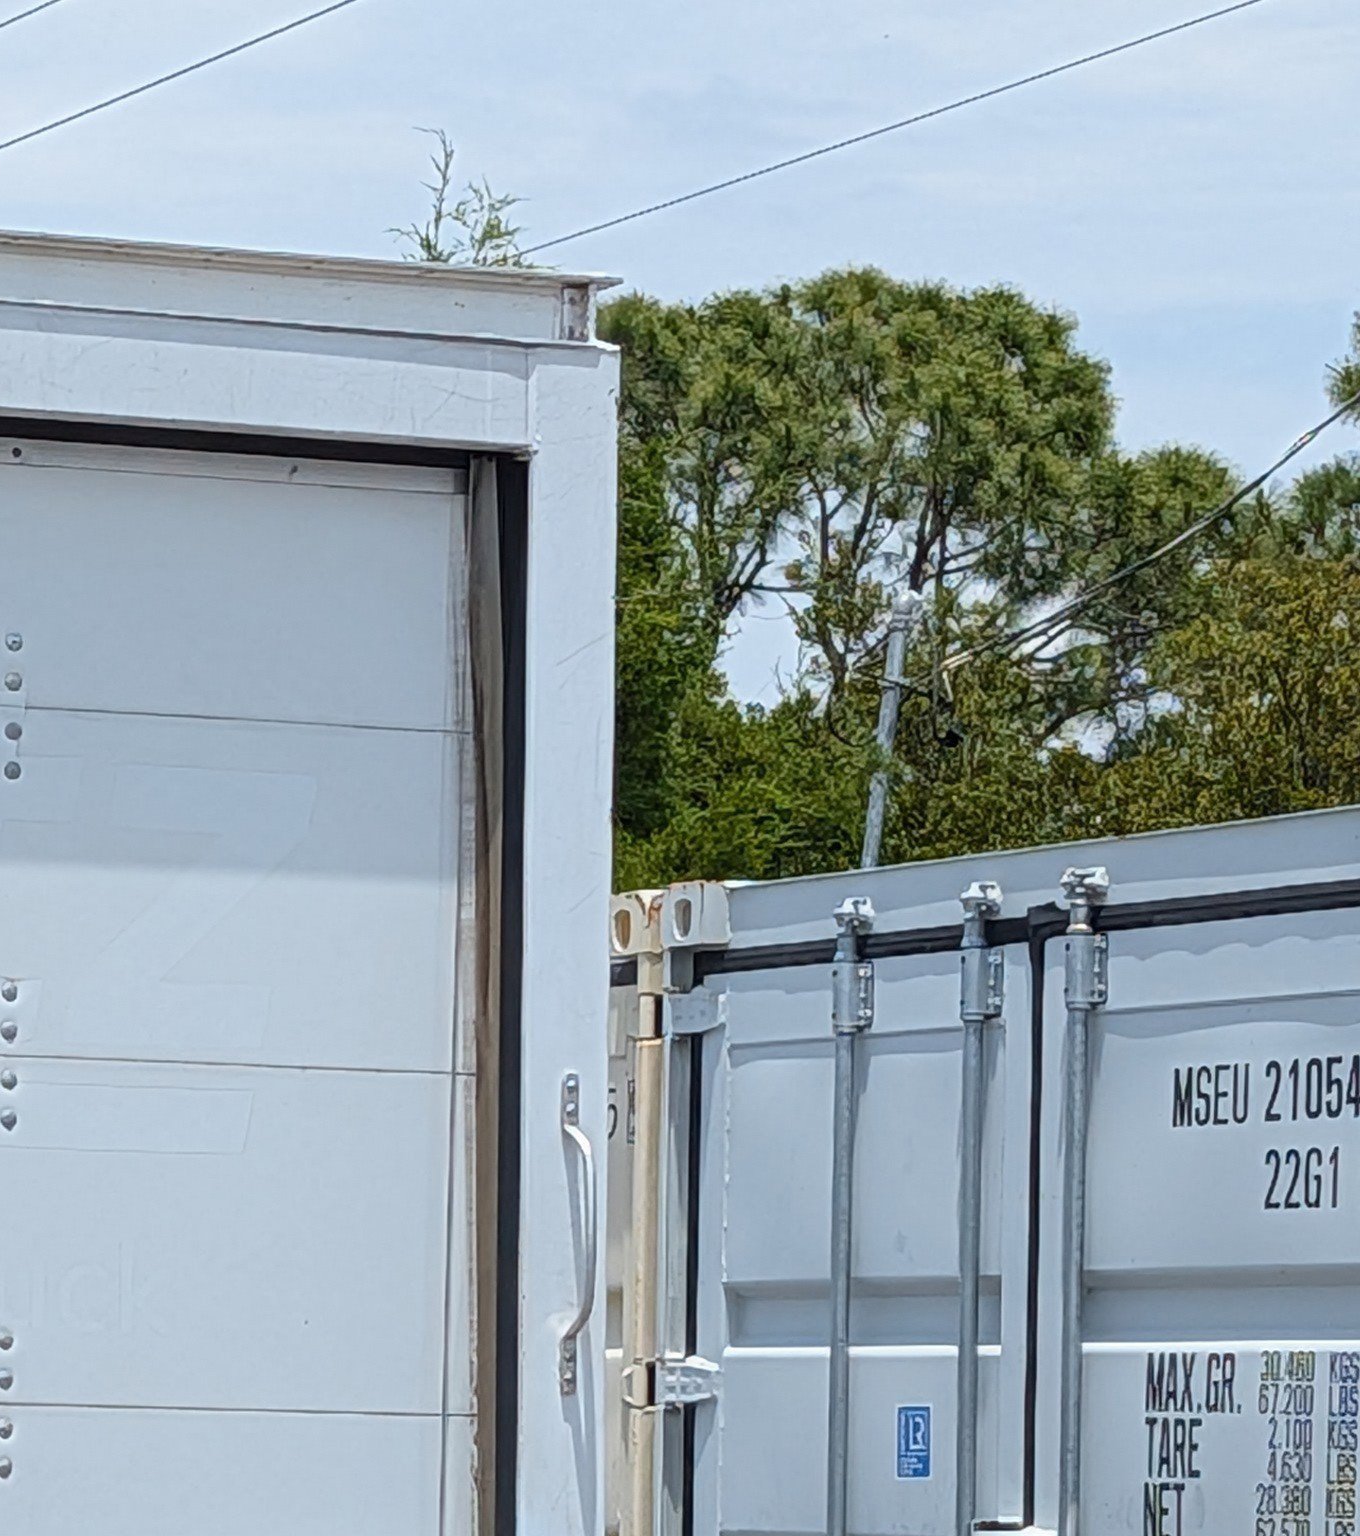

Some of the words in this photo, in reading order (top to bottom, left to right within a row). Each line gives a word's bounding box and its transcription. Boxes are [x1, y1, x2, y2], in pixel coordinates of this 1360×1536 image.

[1172, 1063, 1250, 1128] MSEU
[1264, 1054, 1360, 1123] 21054
[1264, 1146, 1340, 1210] 22G1
[1328, 1385, 1360, 1417] LBS
[1144, 1417, 1203, 1479] TARE
